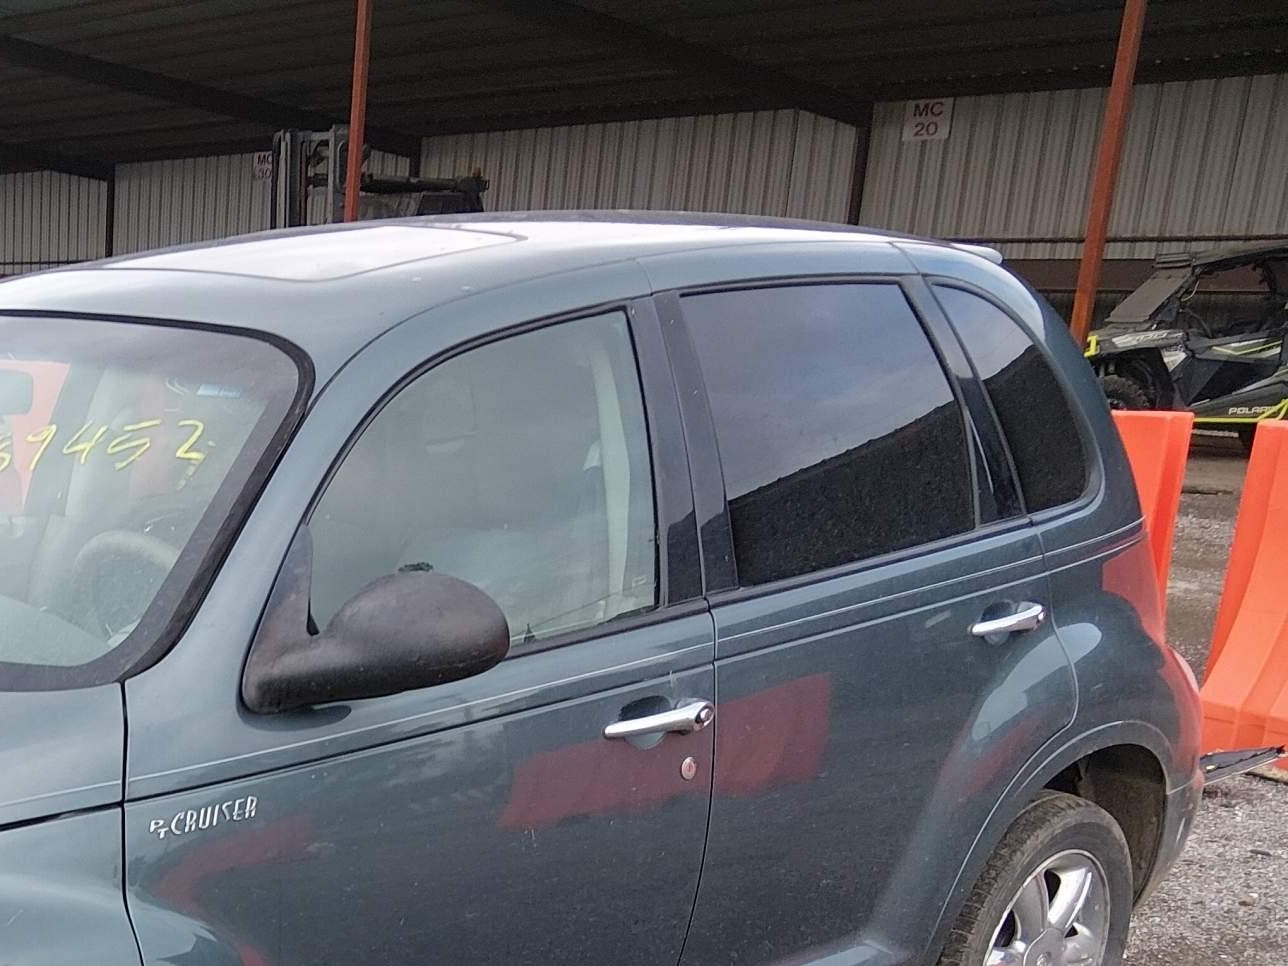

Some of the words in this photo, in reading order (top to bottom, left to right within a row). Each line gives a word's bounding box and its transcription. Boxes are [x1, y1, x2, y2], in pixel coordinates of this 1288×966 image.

[913, 102, 944, 117] MC
[913, 121, 938, 137] 20
[1228, 406, 1279, 415] POLAR
[150, 819, 169, 839] PT
[171, 796, 257, 834] CRUISER
